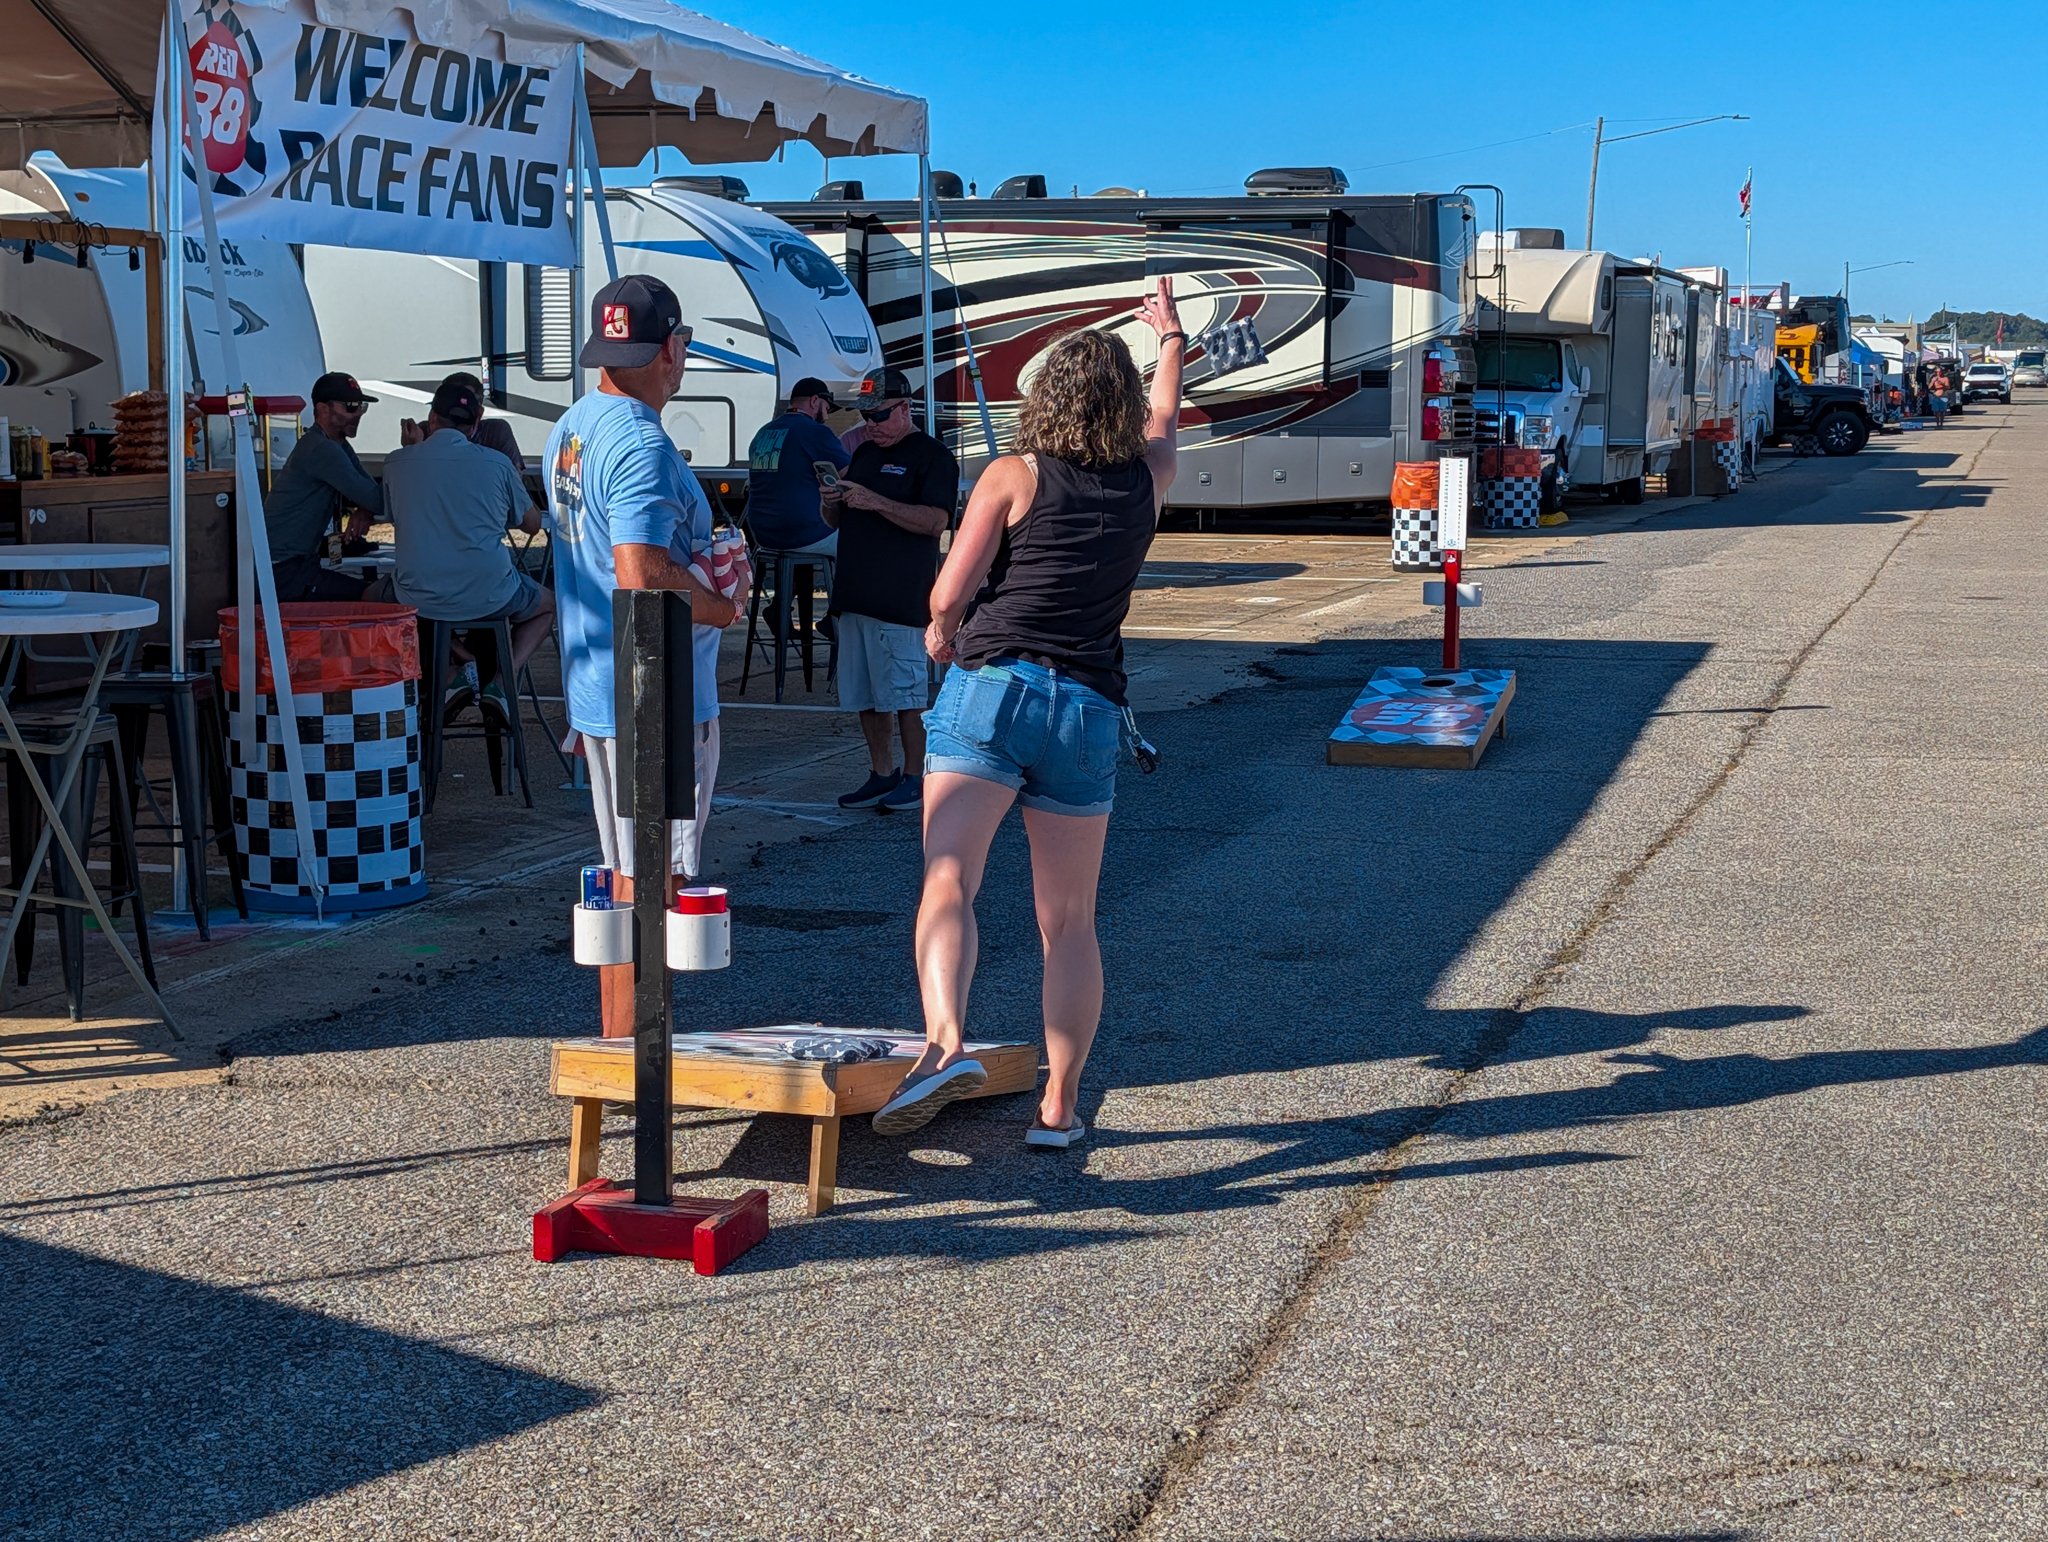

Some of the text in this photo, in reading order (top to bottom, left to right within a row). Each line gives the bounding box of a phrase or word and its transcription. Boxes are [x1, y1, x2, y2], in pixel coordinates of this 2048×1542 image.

[196, 41, 238, 79] RED
[294, 23, 550, 135] WELCOME
[185, 79, 245, 145] 38
[271, 128, 559, 229] RACE FANS
[1361, 710, 1472, 727] 38
[1380, 702, 1468, 712] RED
